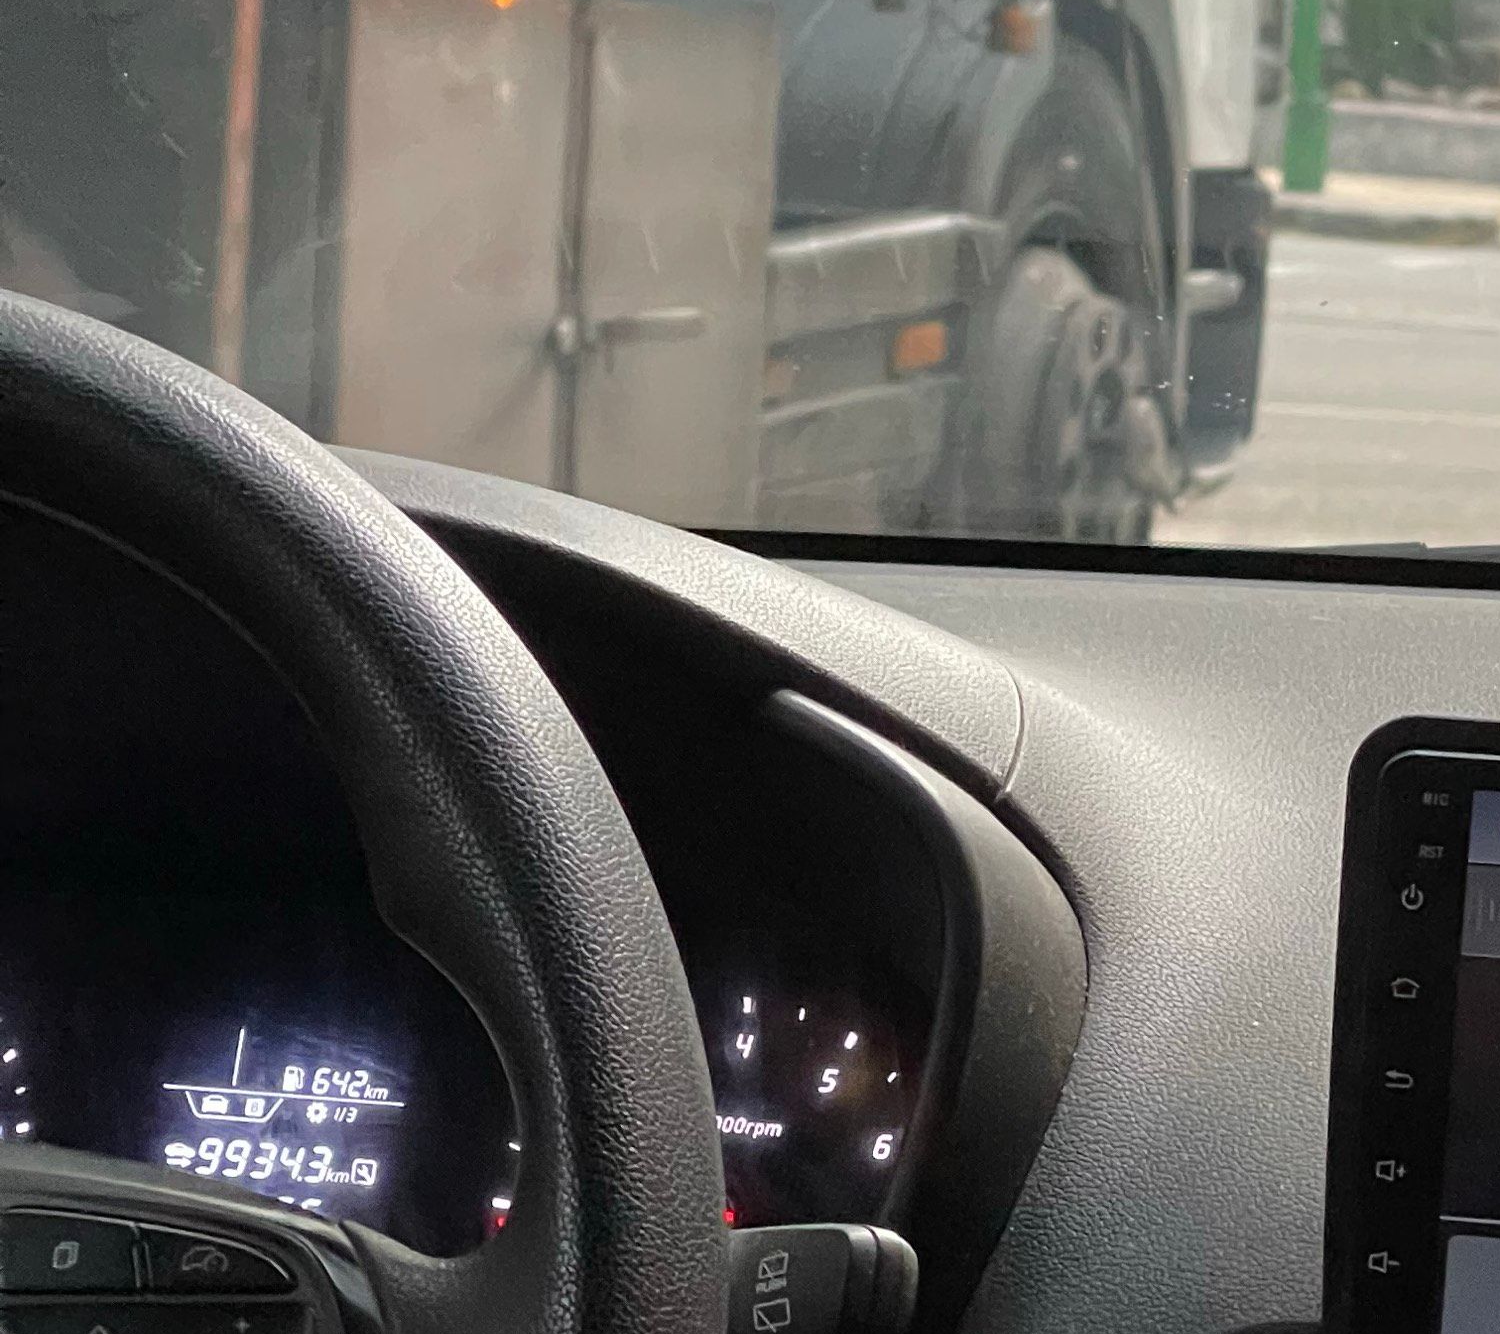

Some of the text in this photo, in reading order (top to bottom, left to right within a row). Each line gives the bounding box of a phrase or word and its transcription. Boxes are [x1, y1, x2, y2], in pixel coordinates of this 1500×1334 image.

[735, 1032, 755, 1060] 4
[817, 1067, 840, 1094] 5
[872, 1133, 894, 1161] 6
